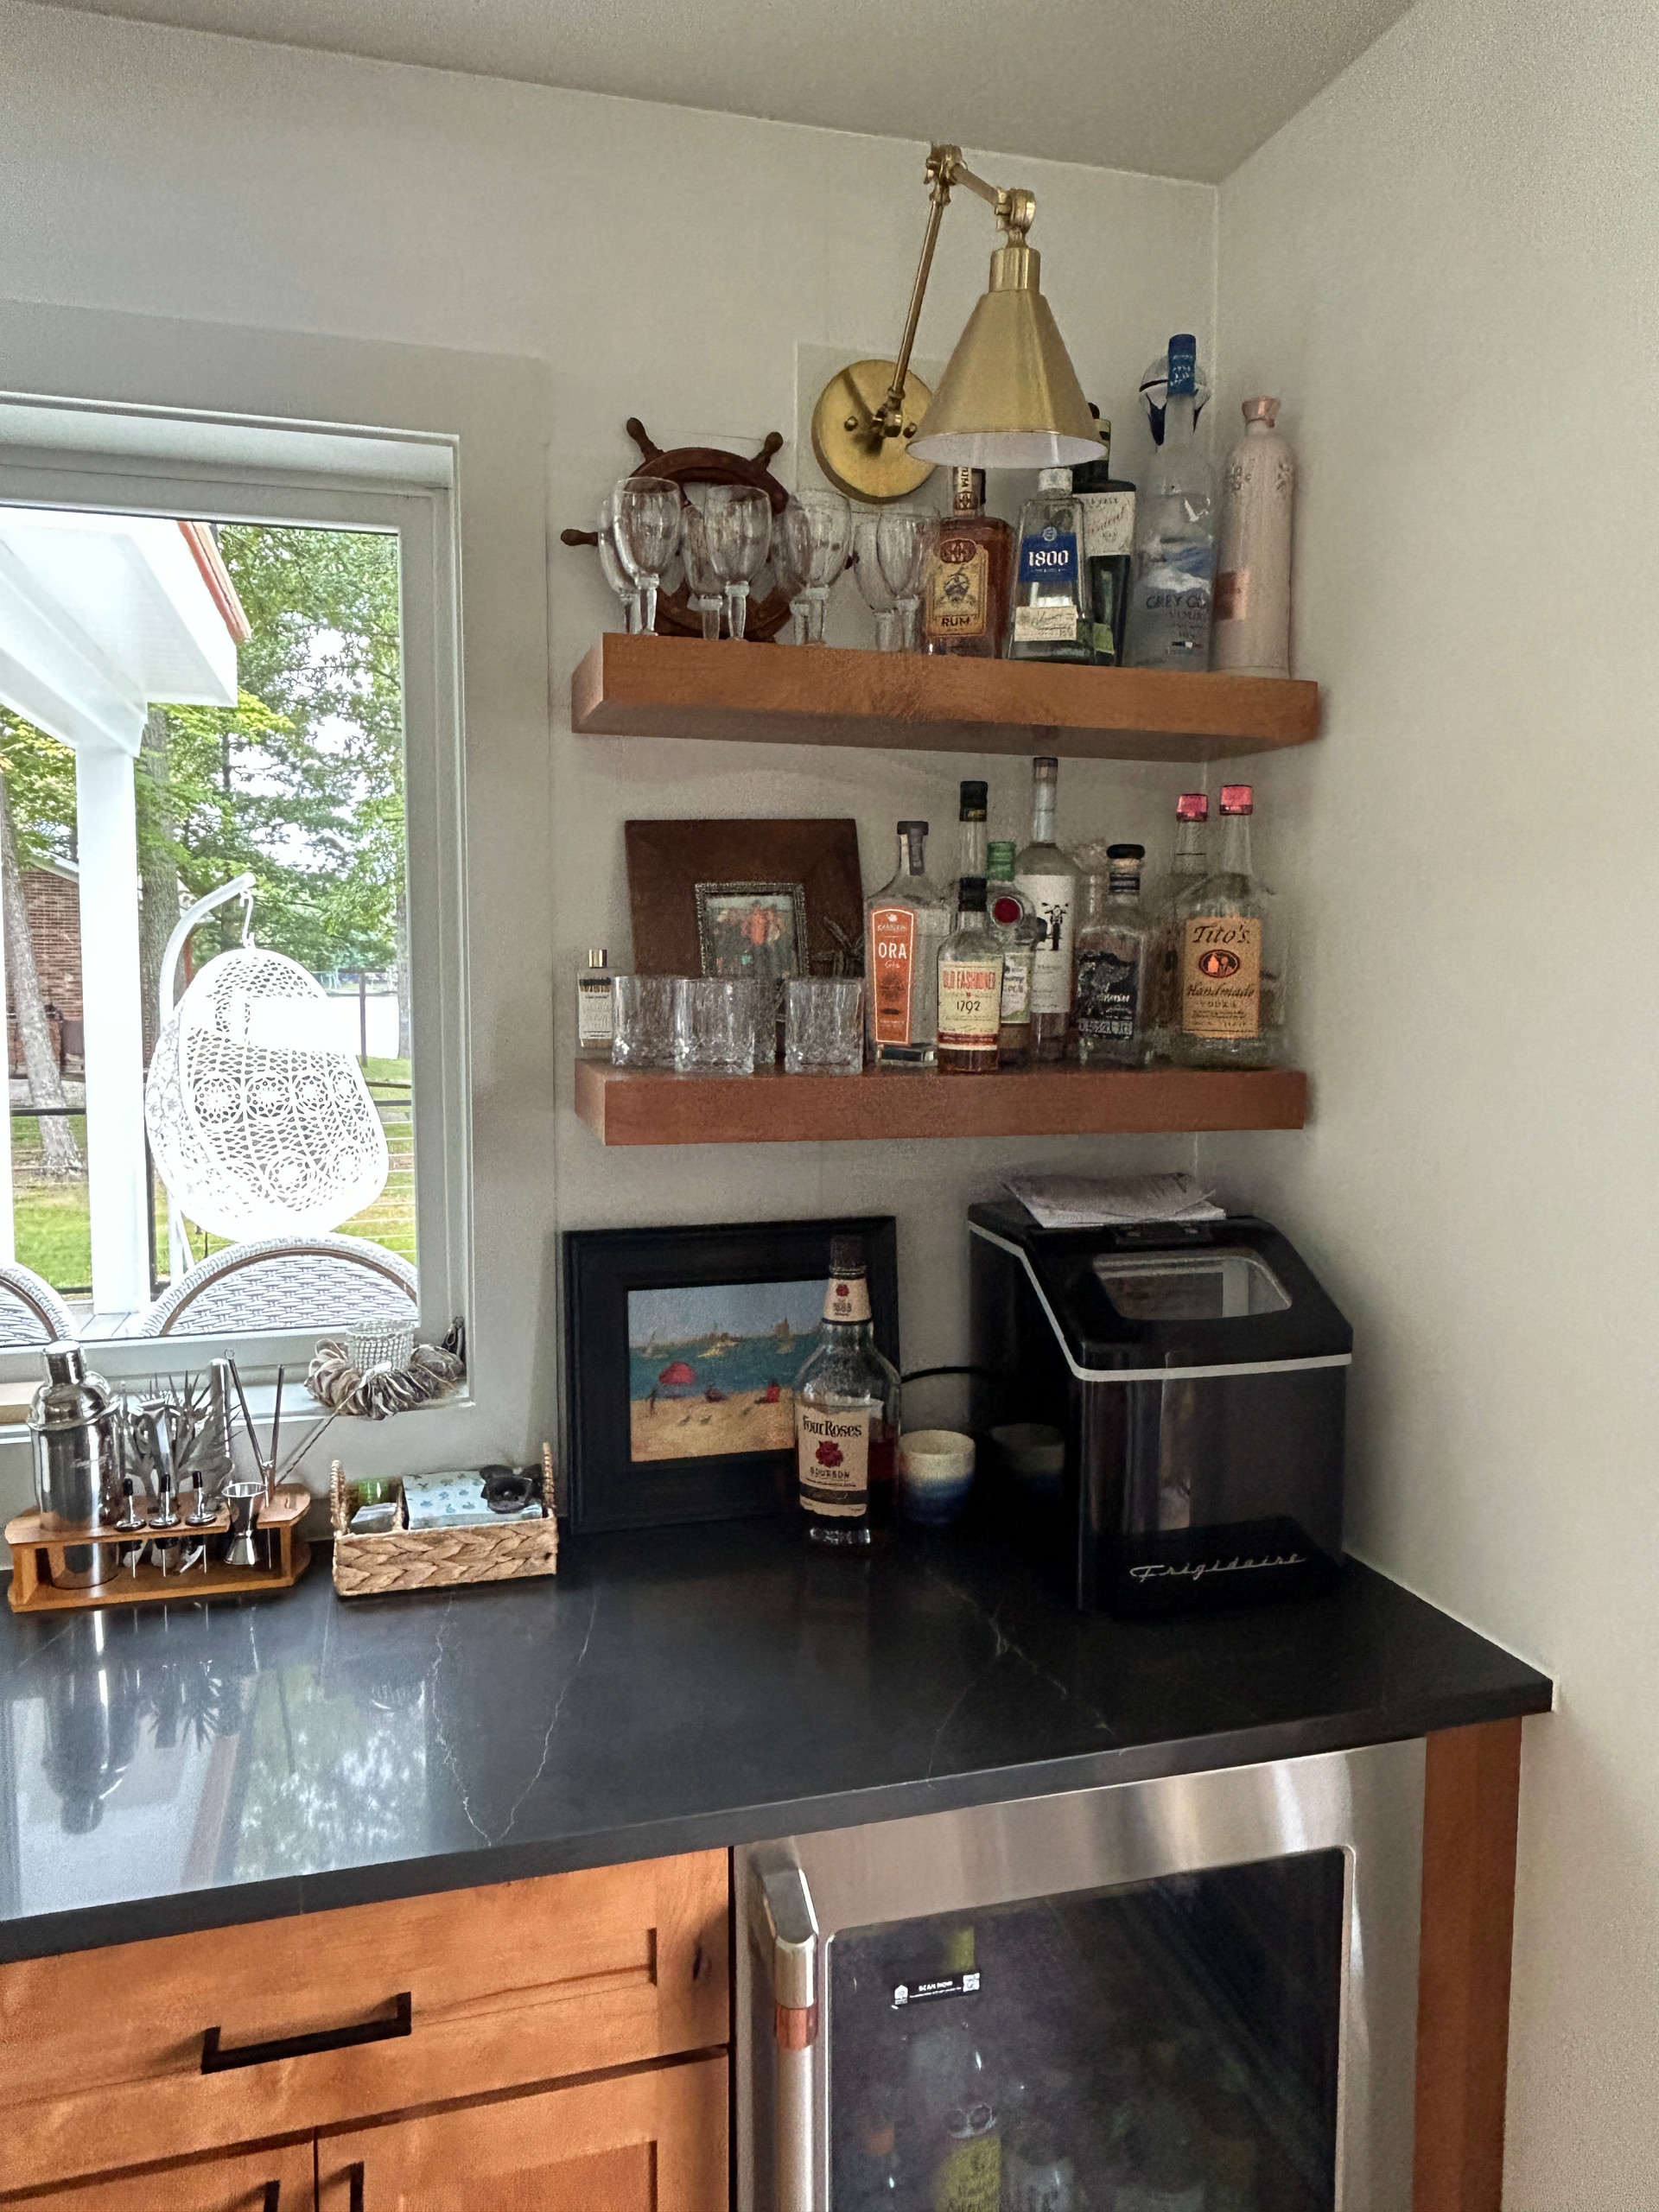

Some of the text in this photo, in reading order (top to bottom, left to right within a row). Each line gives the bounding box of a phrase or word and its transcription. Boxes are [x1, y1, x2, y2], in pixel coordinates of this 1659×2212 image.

[1028, 550, 1069, 567] 1800
[941, 616, 971, 627] RUM
[1192, 925, 1250, 944] Tito's
[878, 942, 907, 959] ORA
[957, 1000, 981, 1014] 1792
[803, 1415, 862, 1438] Four Roses
[1129, 1554, 1306, 1583] Frigidaire
